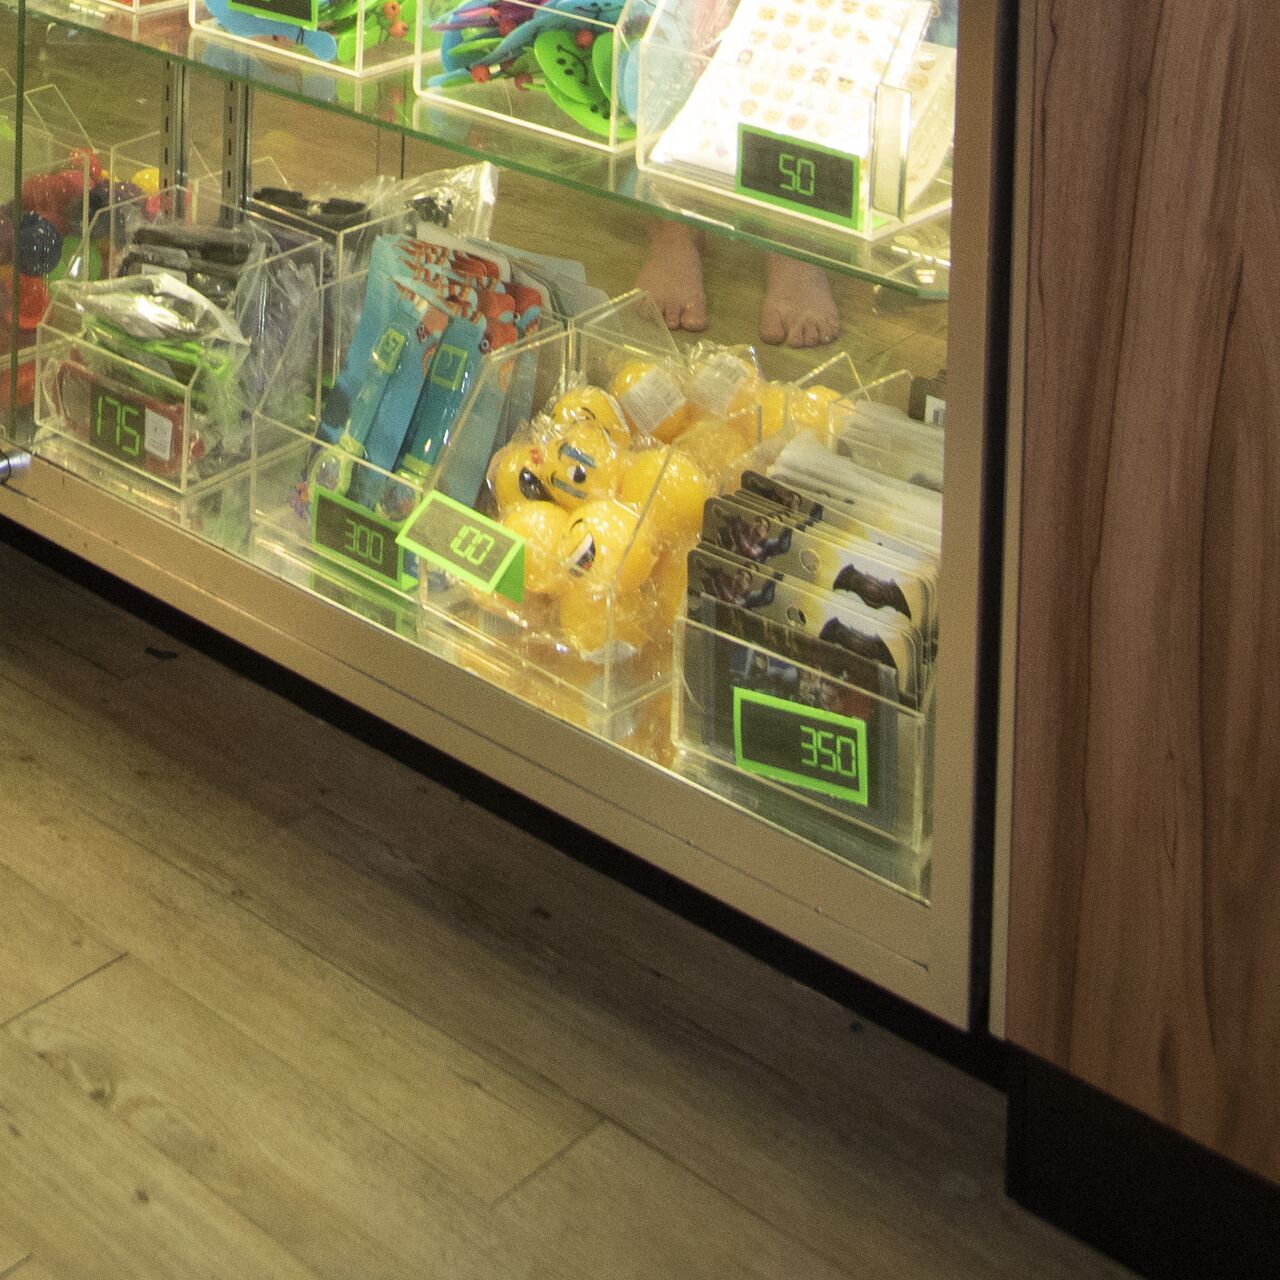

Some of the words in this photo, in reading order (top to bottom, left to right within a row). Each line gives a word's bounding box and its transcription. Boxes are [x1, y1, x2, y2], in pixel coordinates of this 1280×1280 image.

[778, 152, 817, 198] 50
[95, 394, 141, 457] 175
[344, 519, 384, 565] 300
[799, 725, 857, 777] 350
